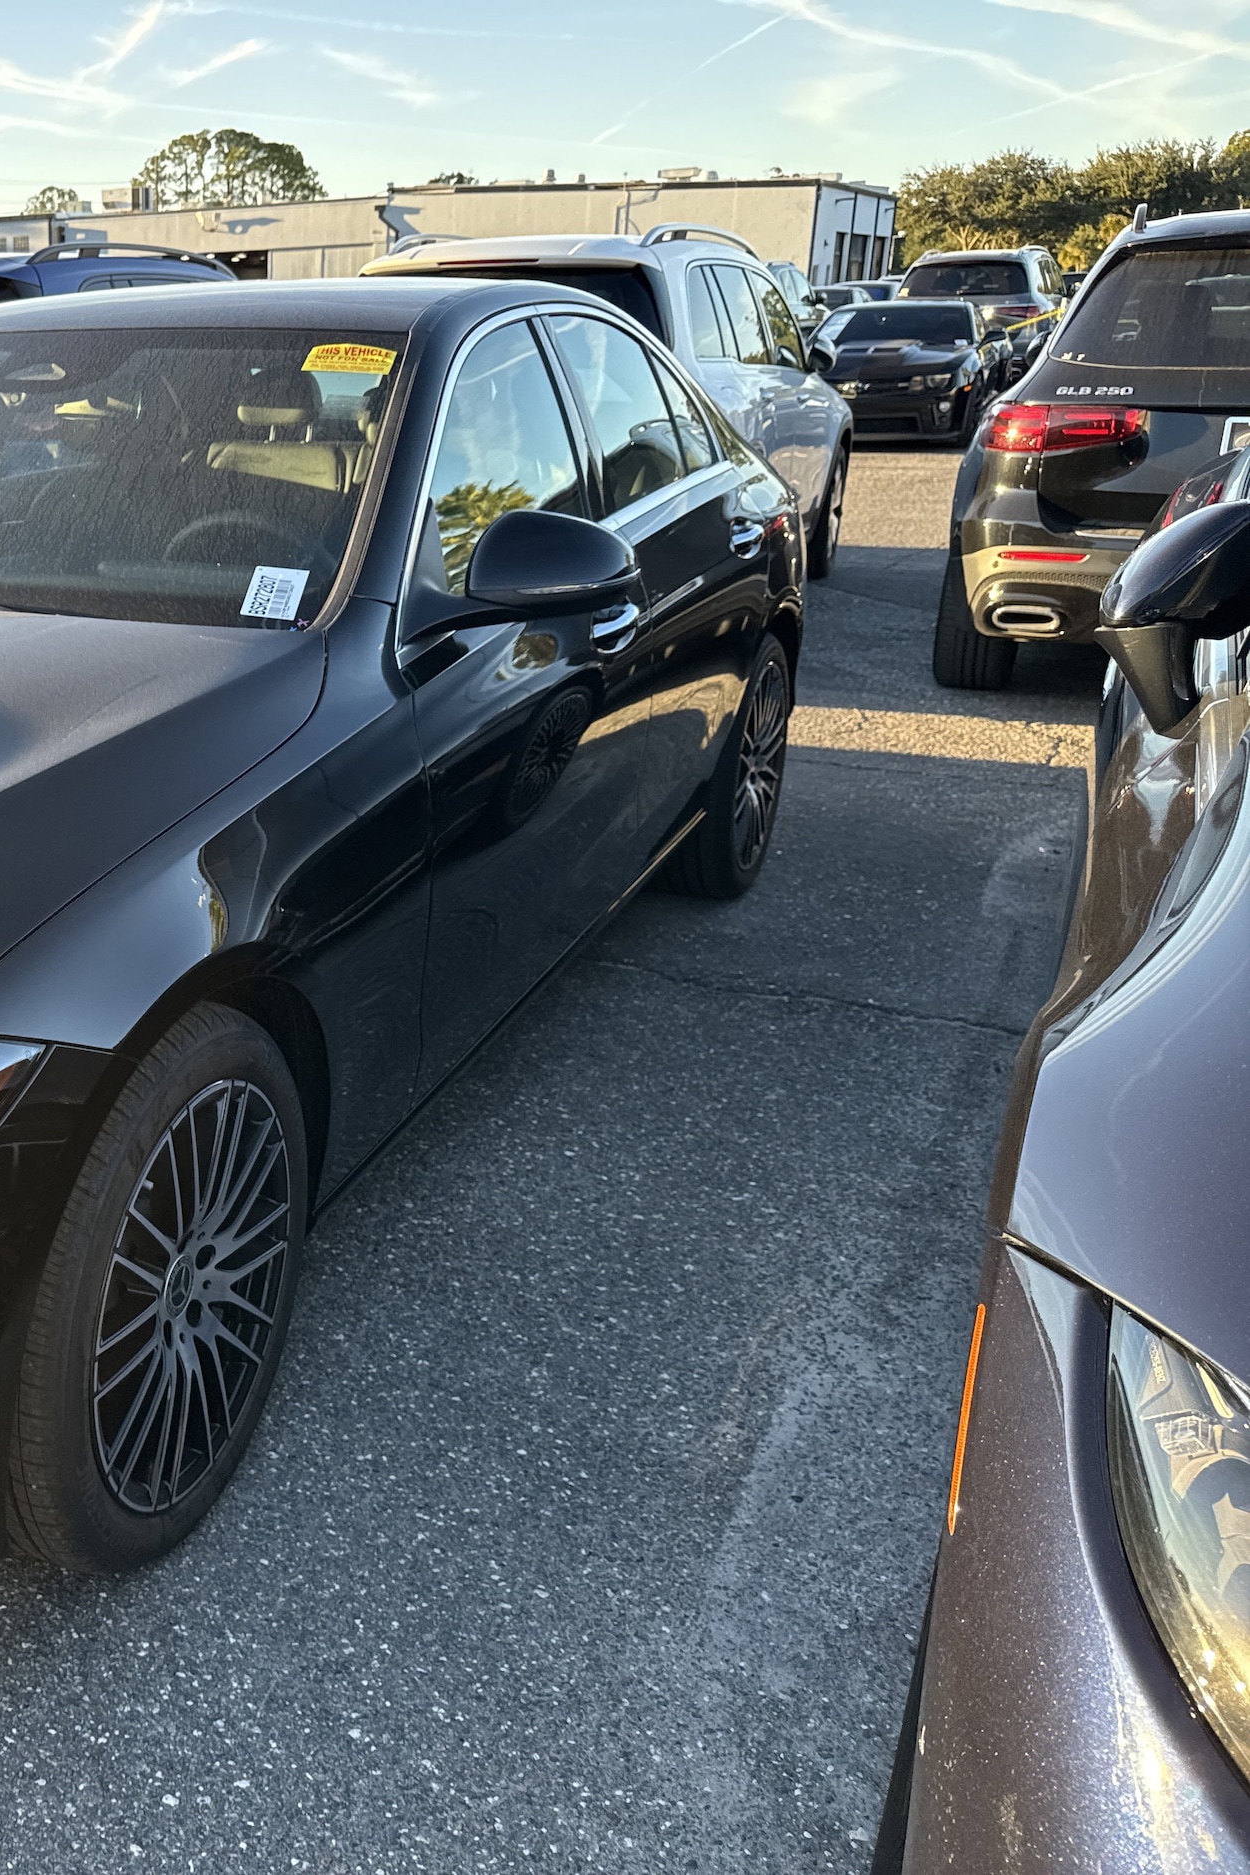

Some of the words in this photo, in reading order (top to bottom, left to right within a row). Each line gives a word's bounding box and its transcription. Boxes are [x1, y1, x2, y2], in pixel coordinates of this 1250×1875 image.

[316, 346, 340, 355] THIS
[344, 346, 393, 358] VEHICLE
[1056, 386, 1091, 395] GLB
[1095, 386, 1134, 395] 250
